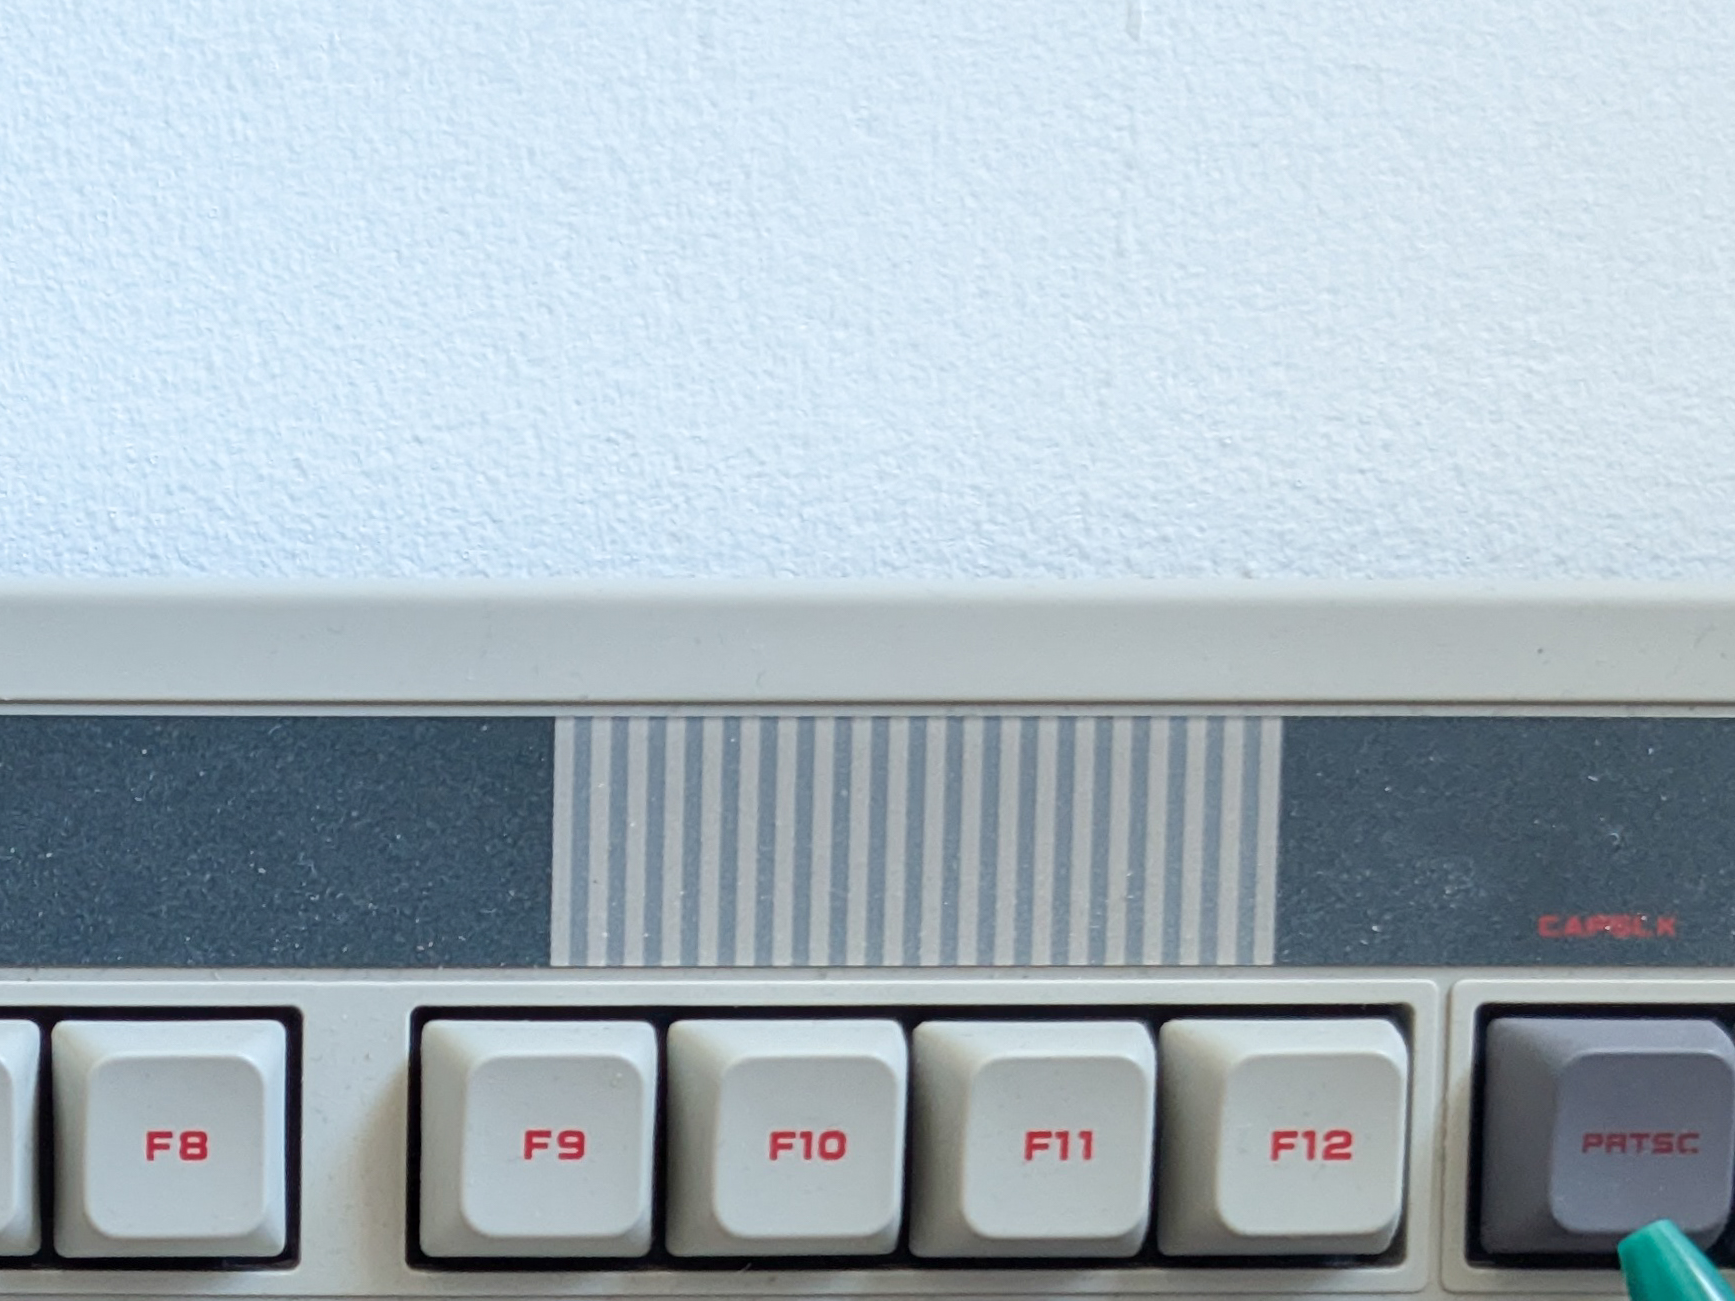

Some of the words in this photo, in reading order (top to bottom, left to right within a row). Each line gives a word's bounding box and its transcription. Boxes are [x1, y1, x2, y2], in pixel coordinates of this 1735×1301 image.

[1537, 914, 1676, 938] CAPSLK
[146, 1131, 208, 1161] F8
[524, 1130, 585, 1160] F9
[770, 1130, 847, 1160] F10
[1025, 1130, 1093, 1160] F11
[1271, 1130, 1353, 1160] F12
[1581, 1131, 1700, 1155] PRTSC
